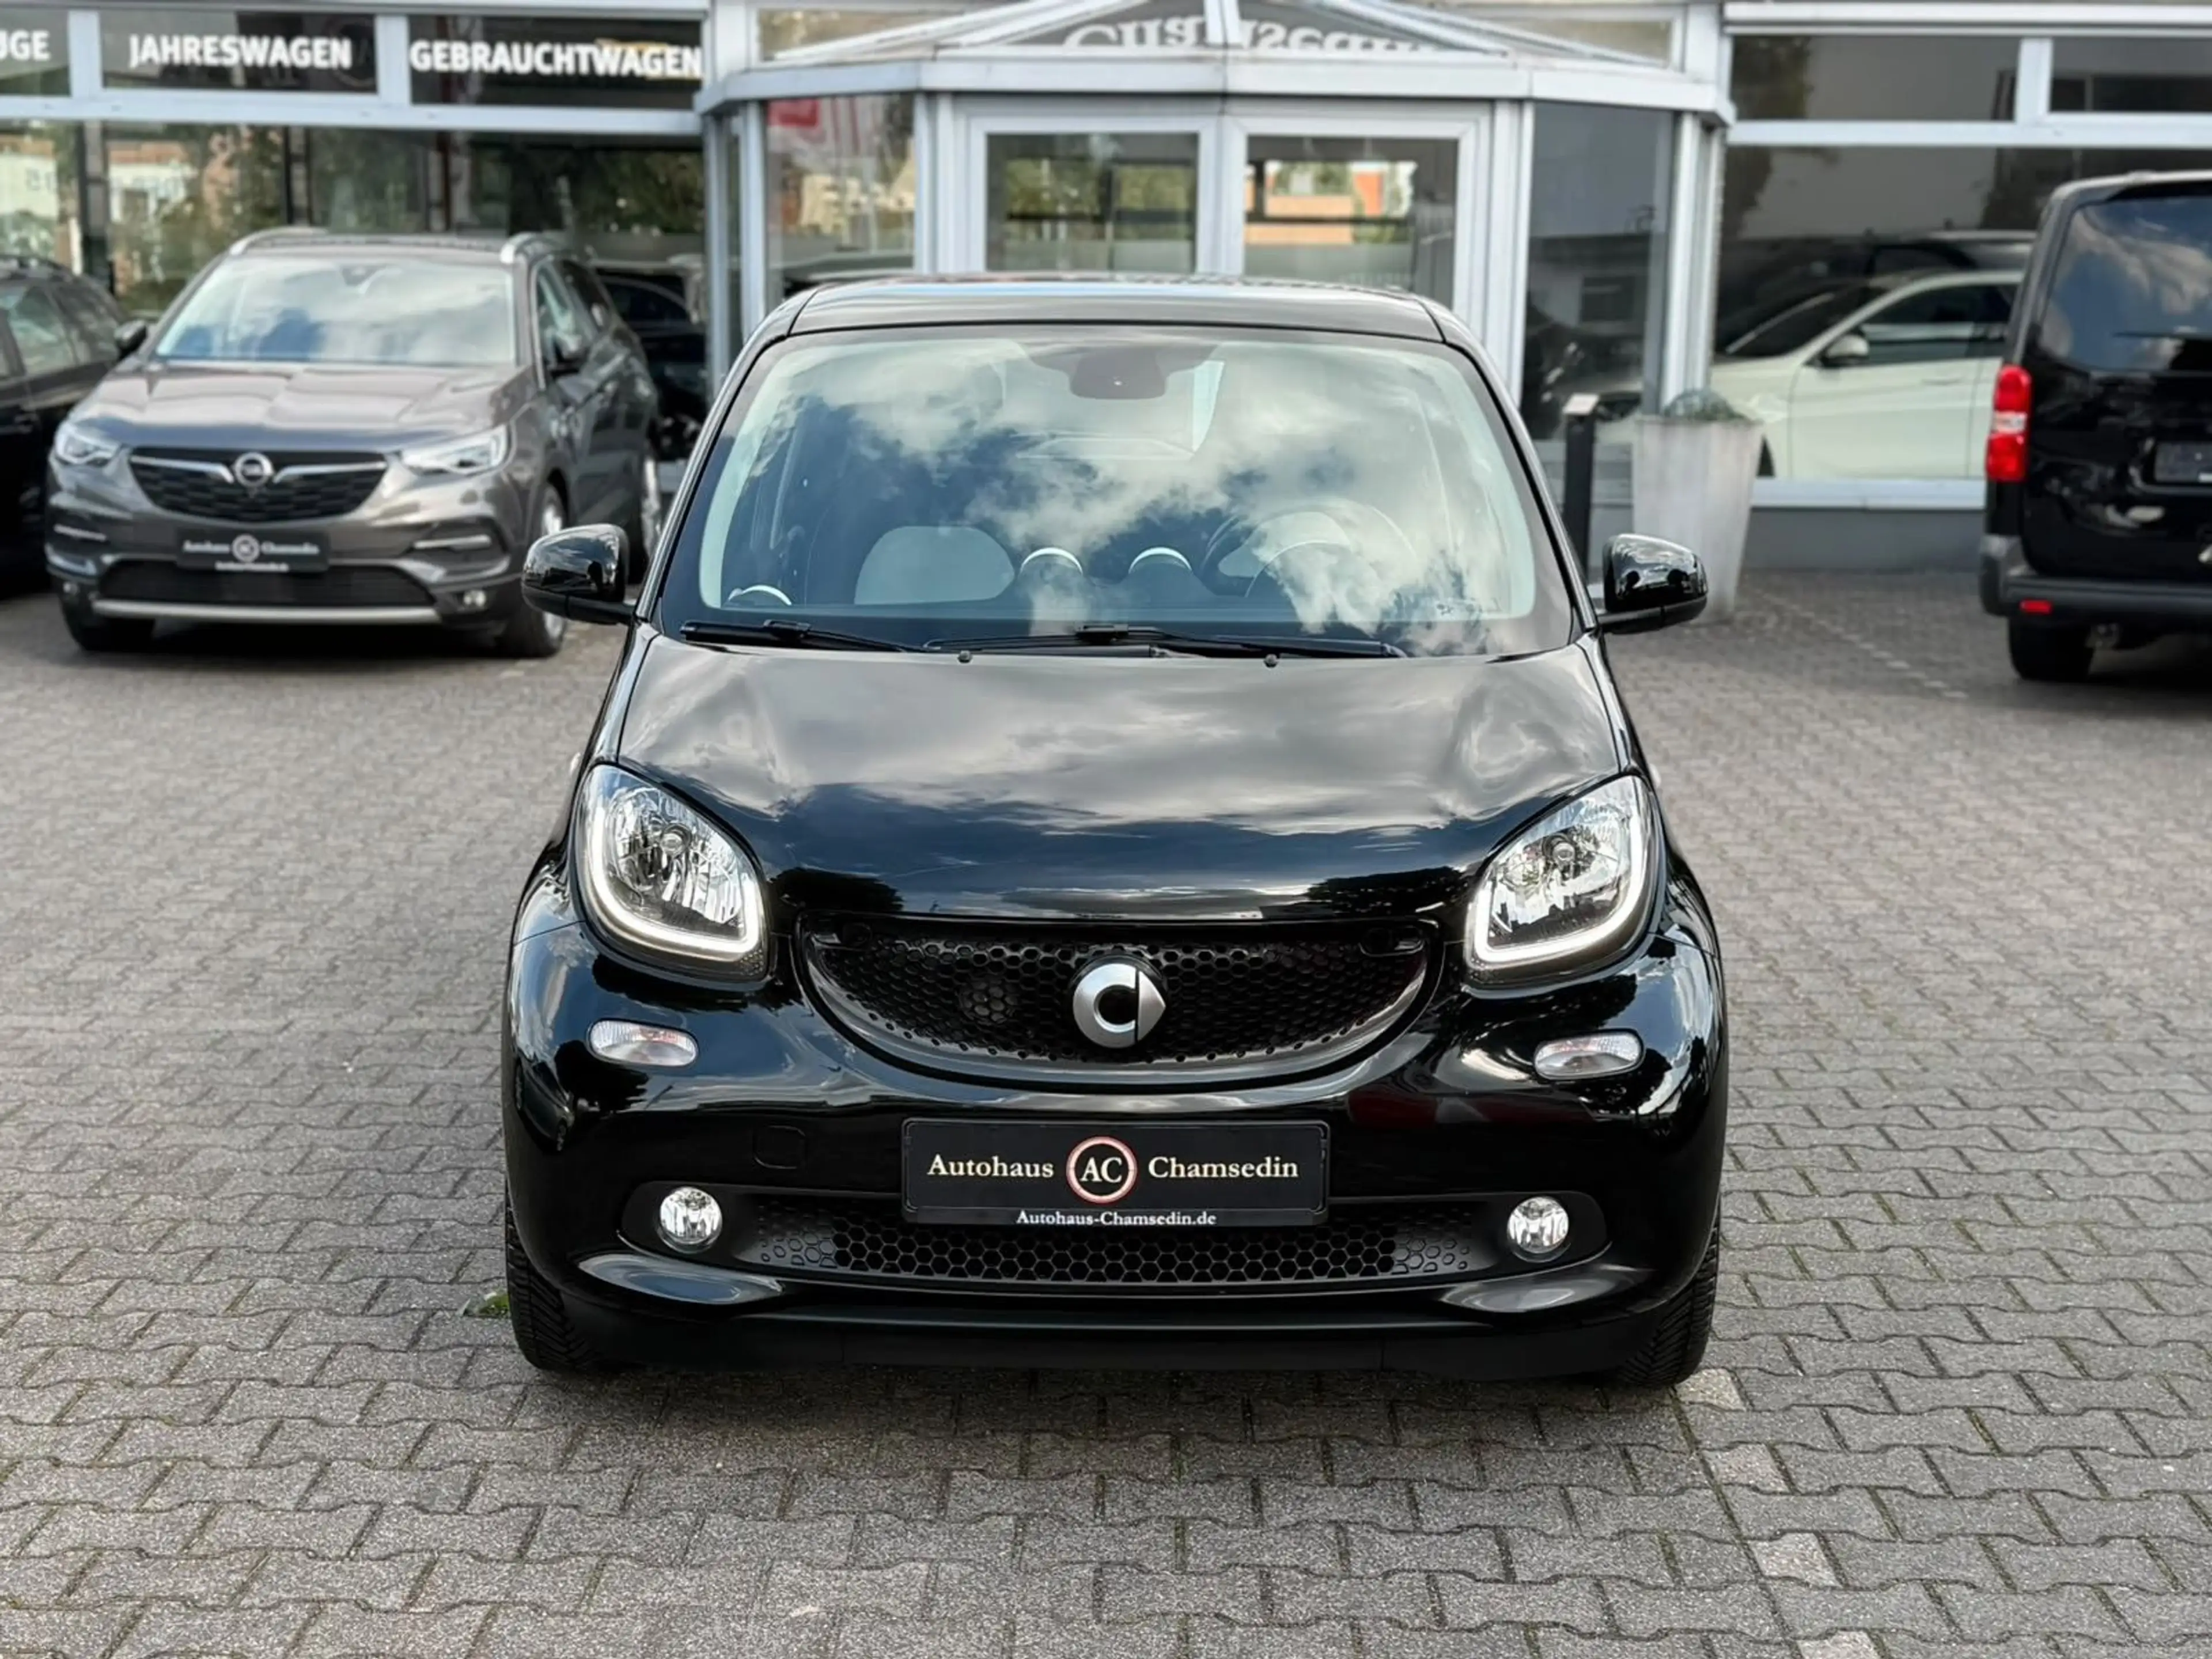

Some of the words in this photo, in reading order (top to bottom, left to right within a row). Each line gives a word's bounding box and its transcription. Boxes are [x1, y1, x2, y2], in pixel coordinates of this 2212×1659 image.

[129, 34, 352, 69] JAHRESWAGEN
[410, 39, 702, 77] GEBRAUCHTWAGEN
[927, 1154, 1054, 1179] Autohaus
[1080, 1157, 1123, 1183] AC
[1148, 1157, 1299, 1179] Chamsedin
[1016, 1211, 1217, 1226] Autohaus-Chamsedin.de
